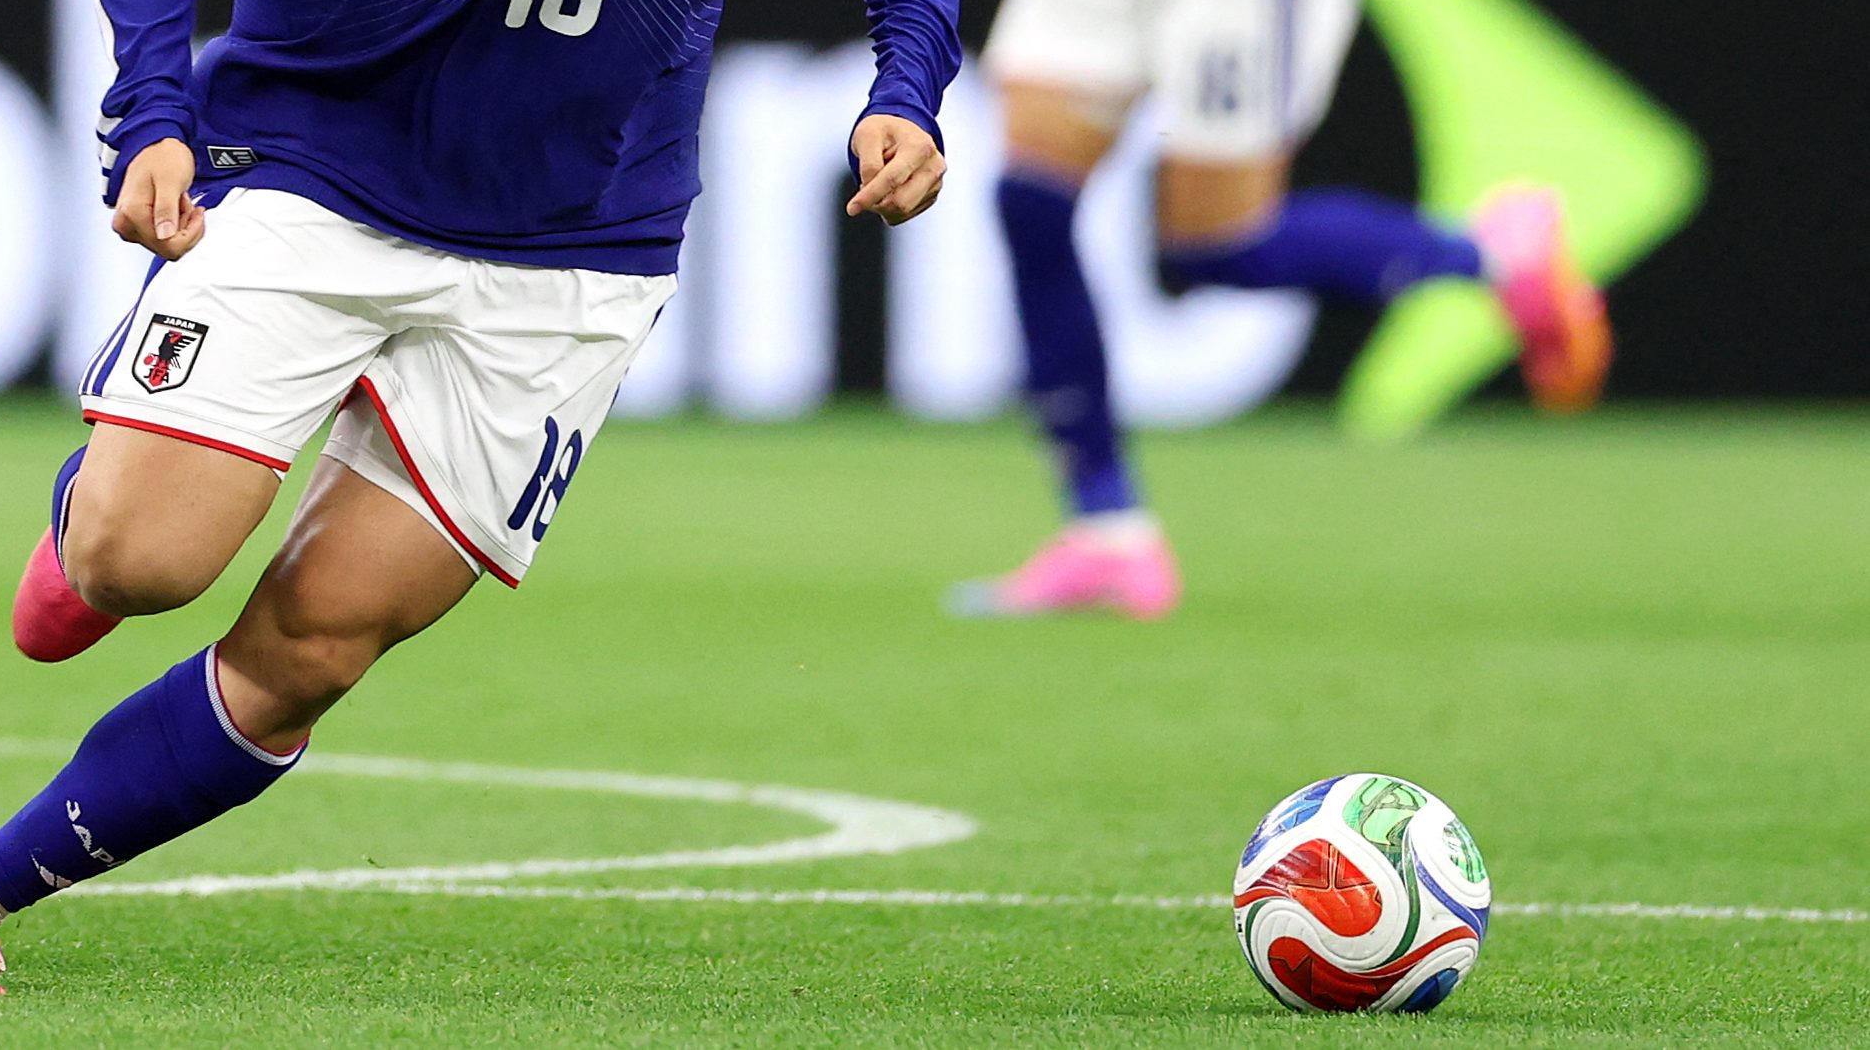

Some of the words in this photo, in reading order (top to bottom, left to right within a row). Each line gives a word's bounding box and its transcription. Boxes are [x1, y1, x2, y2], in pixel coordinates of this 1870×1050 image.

[163, 317, 196, 330] JAPAN
[143, 368, 170, 384] JFA
[507, 415, 583, 542] 18
[66, 799, 126, 868] JAP
